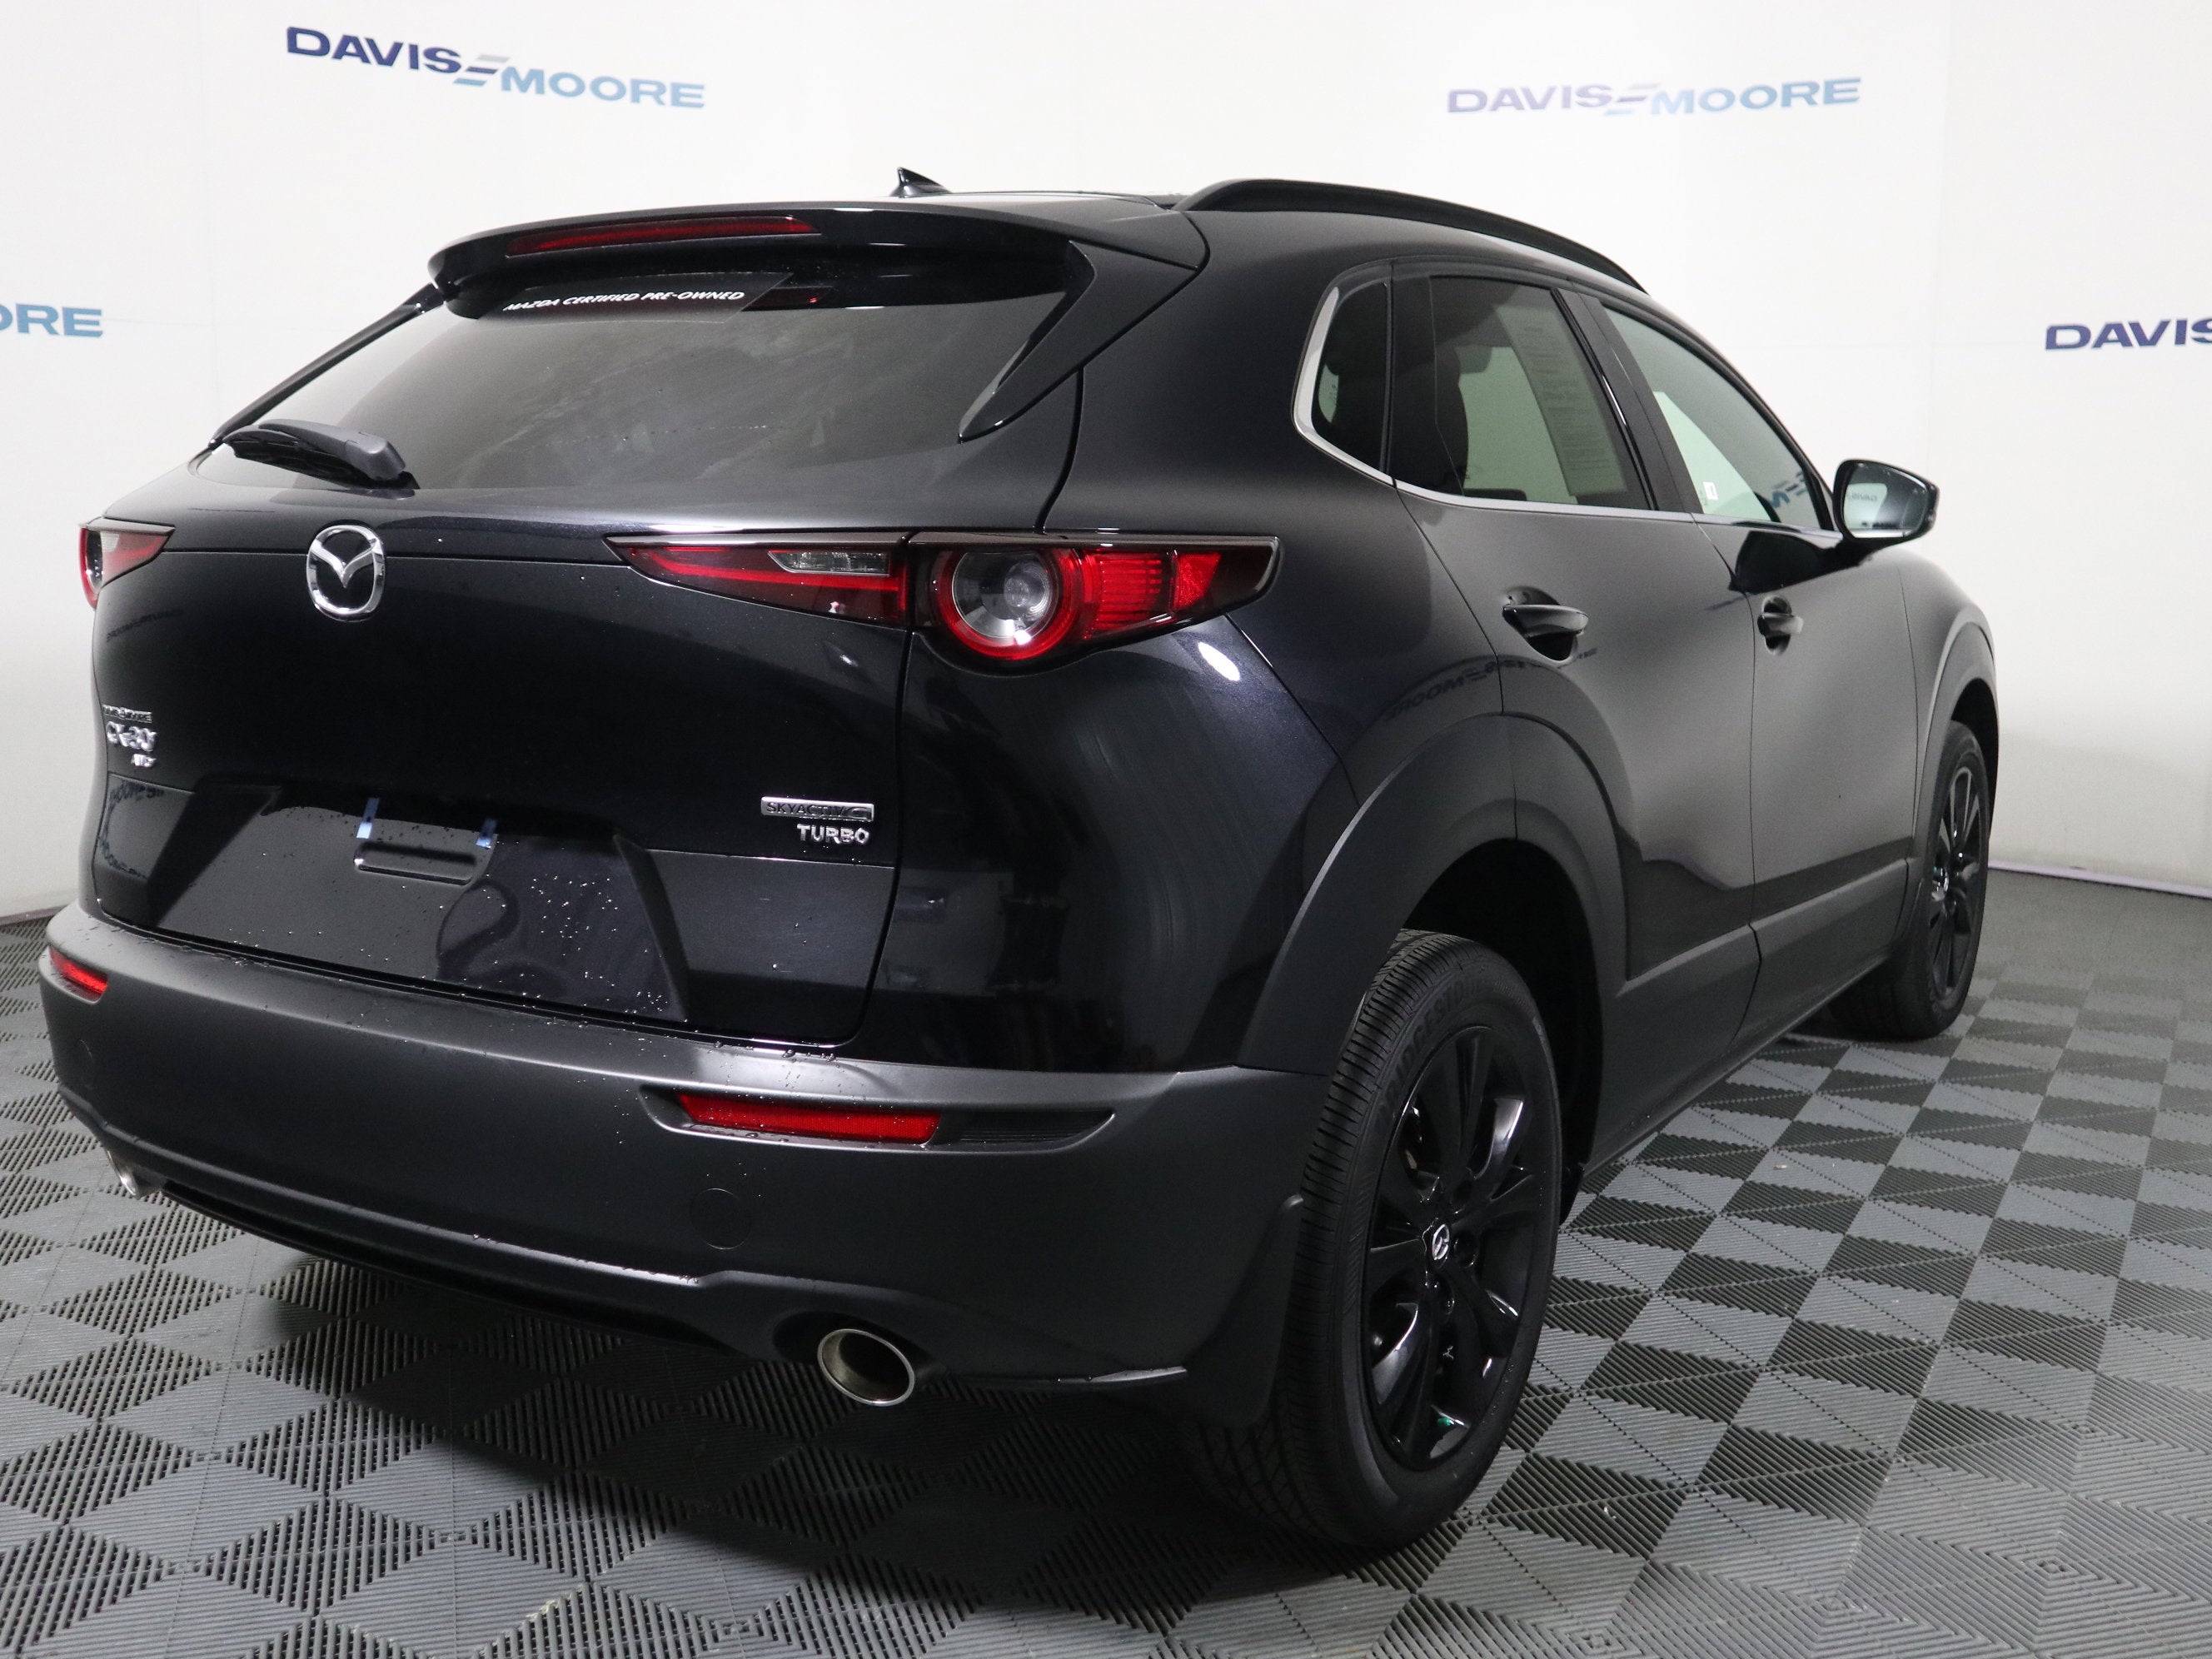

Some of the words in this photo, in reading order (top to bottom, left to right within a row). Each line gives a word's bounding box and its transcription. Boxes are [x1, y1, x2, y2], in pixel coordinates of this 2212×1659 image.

[286, 26, 462, 74] DAVIS
[501, 66, 705, 109] MOORE
[1447, 83, 1612, 113] DAVIS
[1650, 77, 1861, 116] MOORE
[503, 298, 560, 311] MAZDA
[562, 293, 640, 306] CERTIFIED
[640, 291, 745, 301] PRE-OWNED
[797, 823, 869, 844] TURBO
